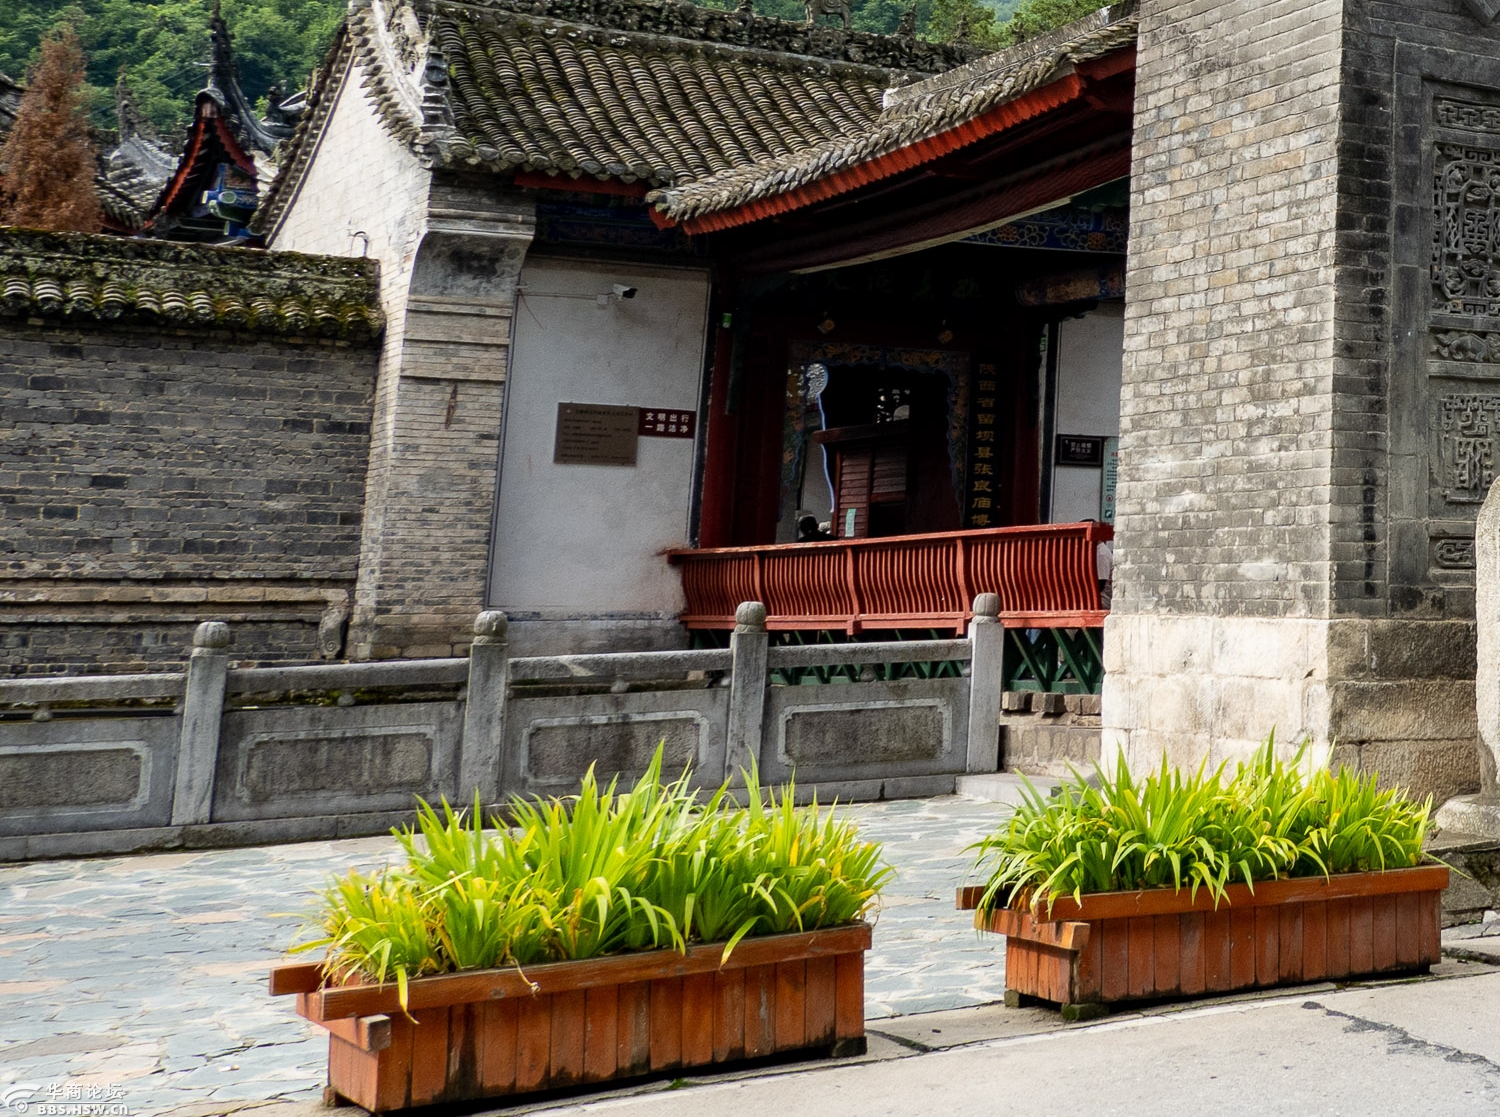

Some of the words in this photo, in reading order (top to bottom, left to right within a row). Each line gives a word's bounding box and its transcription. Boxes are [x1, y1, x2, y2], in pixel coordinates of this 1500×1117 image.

[645, 412, 690, 423] 文明出行
[645, 423, 689, 433] 一路洁净
